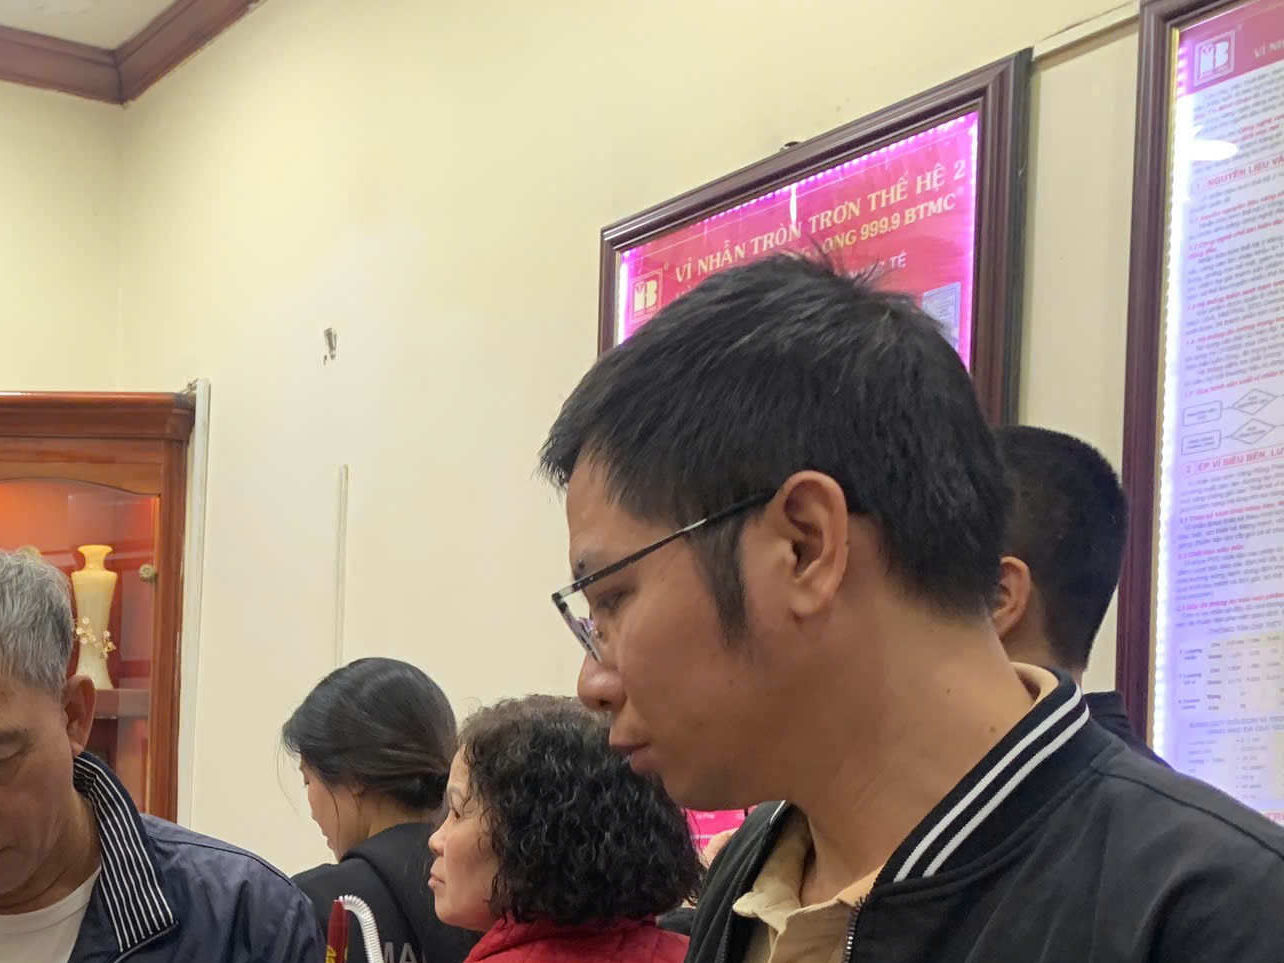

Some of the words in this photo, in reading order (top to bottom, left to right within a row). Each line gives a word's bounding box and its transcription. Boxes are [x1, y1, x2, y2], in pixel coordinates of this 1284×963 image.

[697, 239, 746, 276] NHẪN
[750, 221, 803, 256] TRÒN
[808, 197, 862, 235] TRƠN
[868, 170, 909, 212] THẾ
[916, 162, 945, 195] HỆ
[953, 159, 966, 180] 2
[860, 212, 901, 241] 999.9
[905, 193, 957, 226] BTMC
